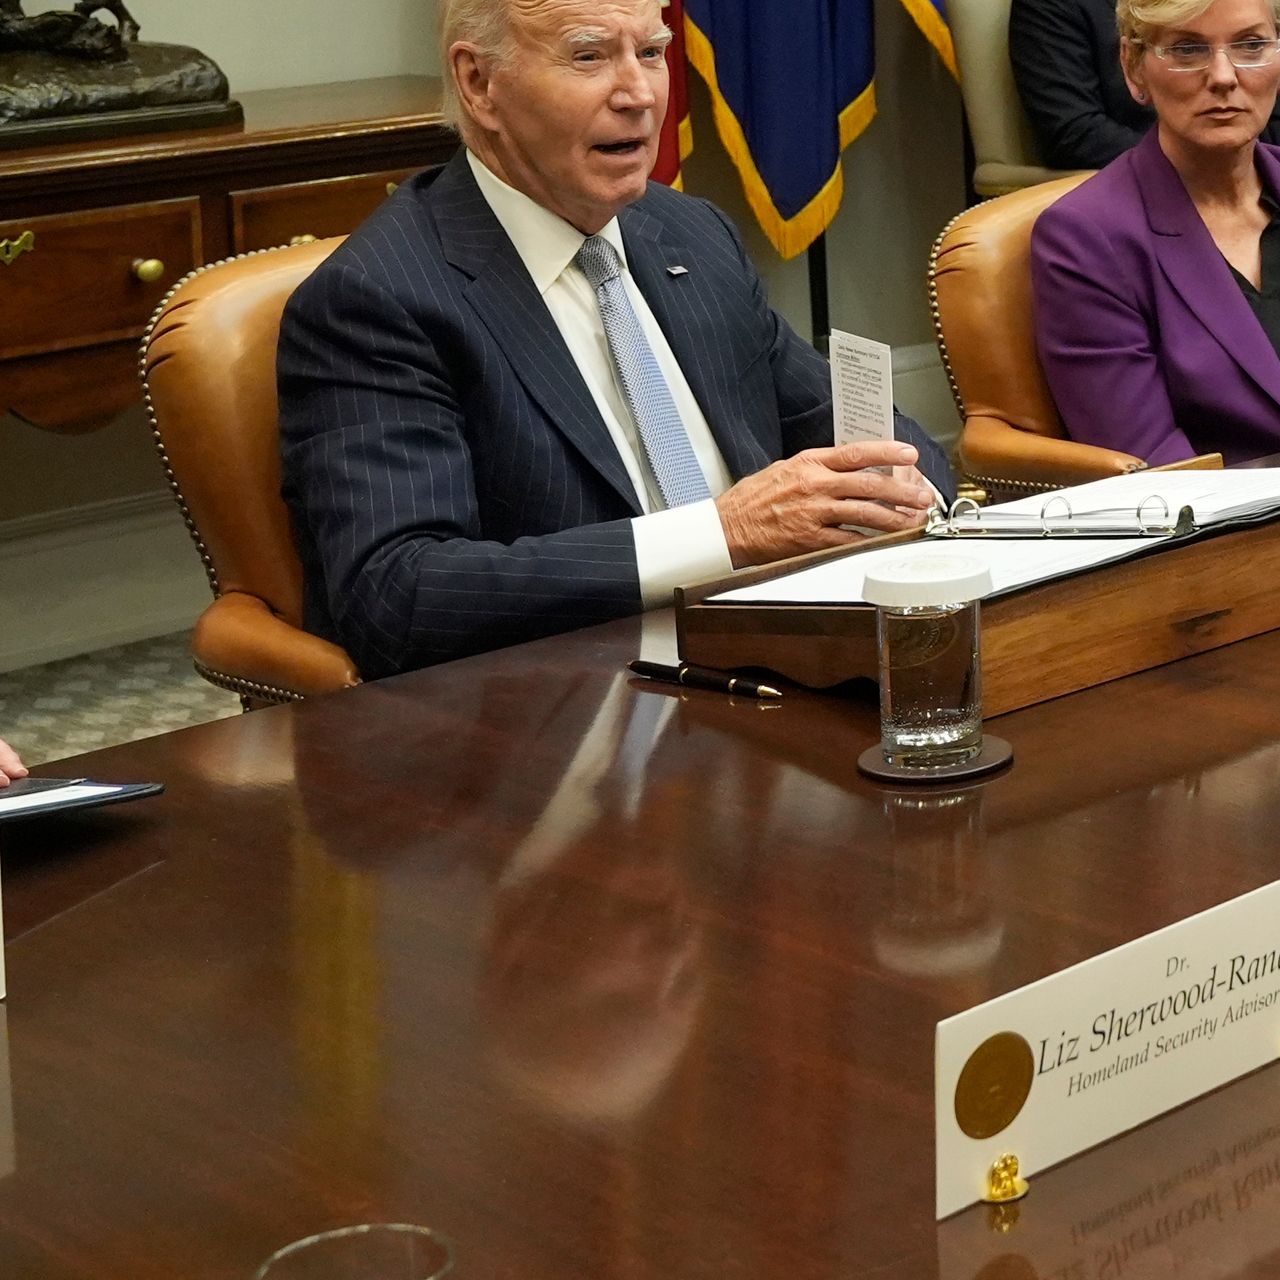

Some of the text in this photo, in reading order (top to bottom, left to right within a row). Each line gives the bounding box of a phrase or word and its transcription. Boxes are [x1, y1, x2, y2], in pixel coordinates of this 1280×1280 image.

[1166, 956, 1190, 978] Dr.
[1037, 1030, 1081, 1076] Liz
[1067, 988, 1280, 1097] Homeland Security Advisor
